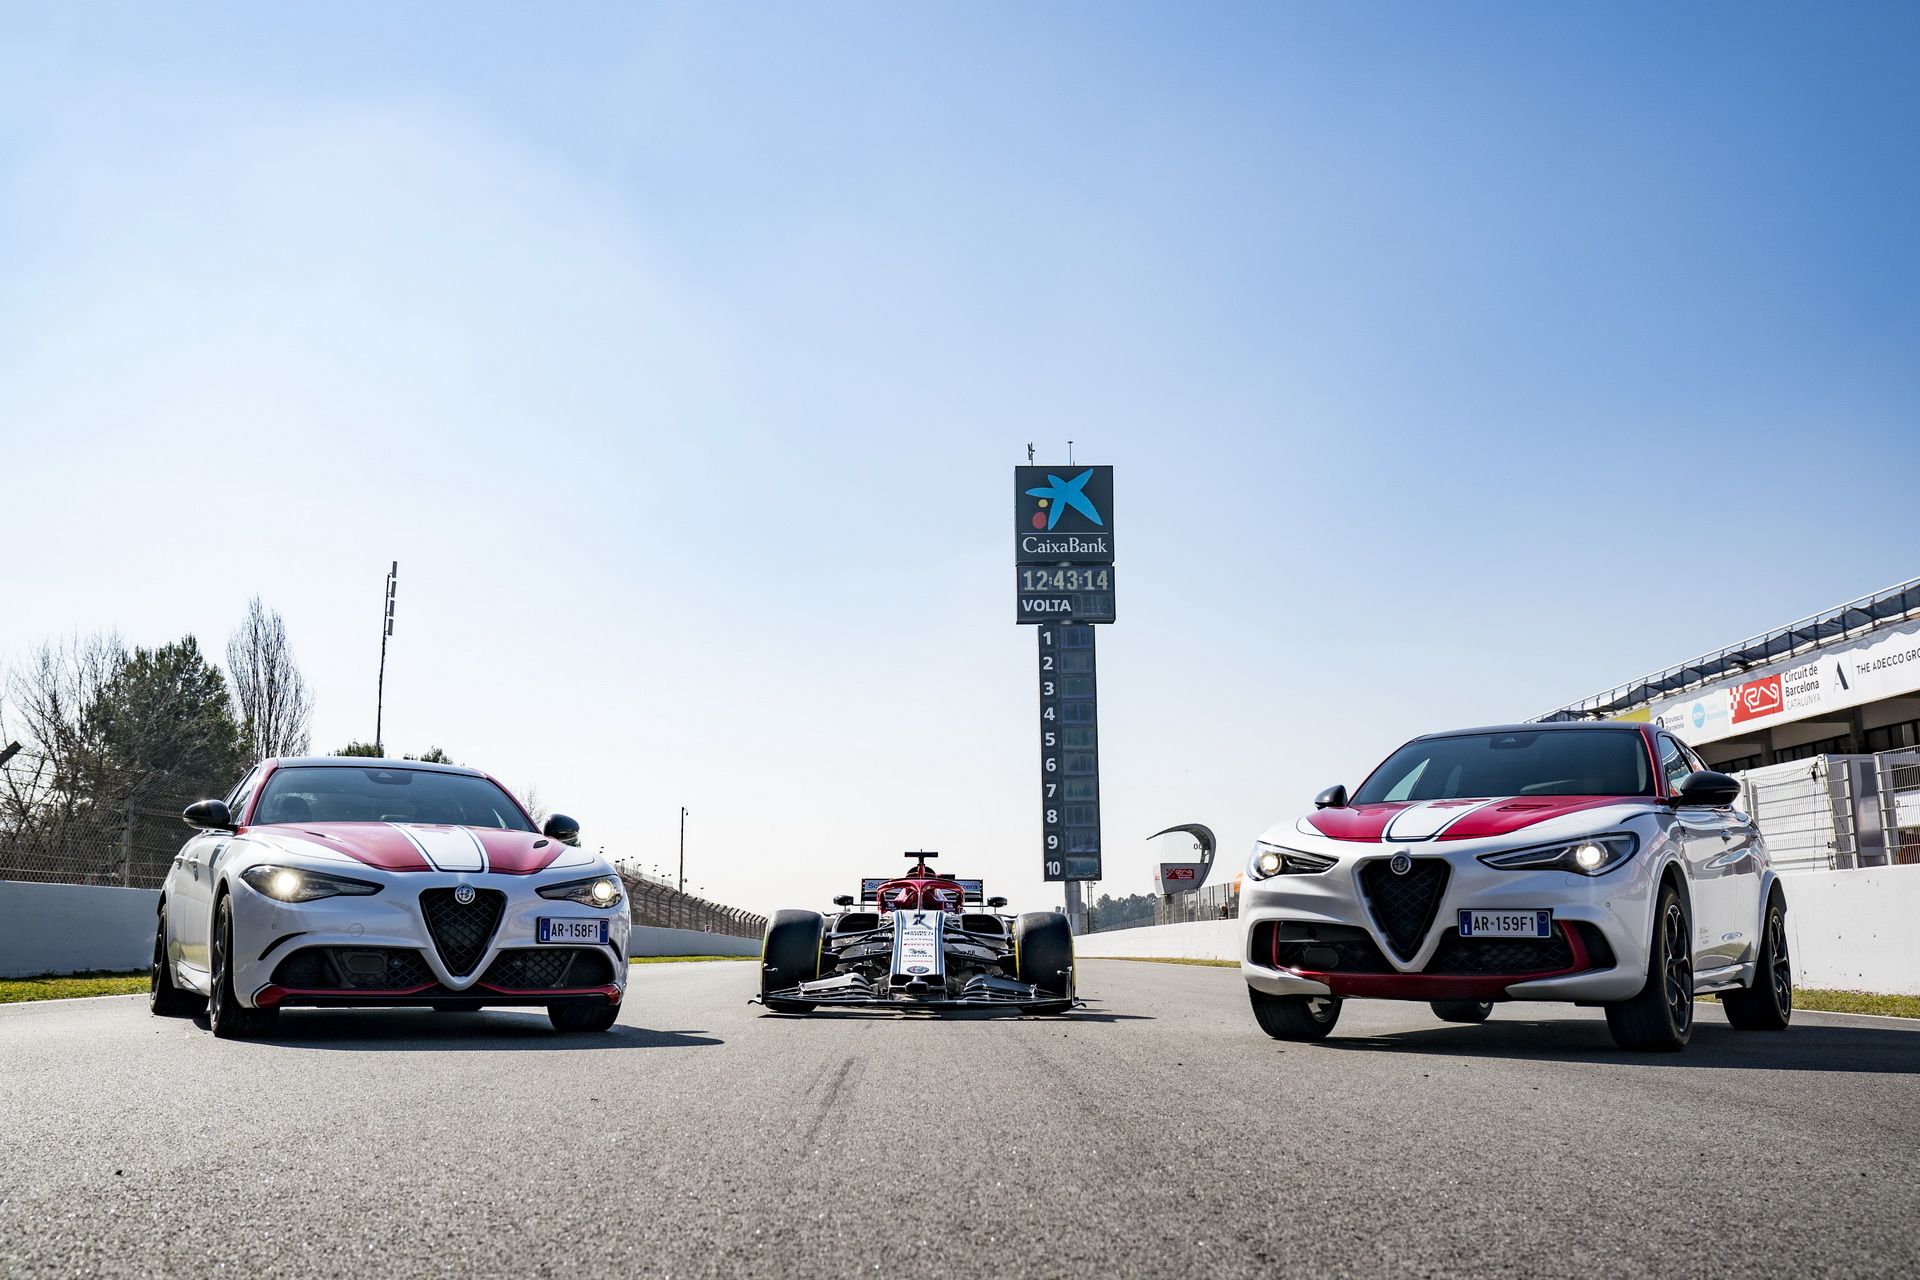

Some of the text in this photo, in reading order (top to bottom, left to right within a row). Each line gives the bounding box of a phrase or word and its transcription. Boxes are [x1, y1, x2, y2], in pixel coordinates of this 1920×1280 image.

[1022, 536, 1107, 553] CaixaBank
[1023, 570, 1108, 591] 12:43:14
[1022, 599, 1072, 612] VOLTA
[1043, 631, 1051, 645] 1
[1043, 656, 1054, 670] 2
[1856, 662, 1871, 675] THE
[1872, 653, 1904, 671] ADECCO
[1784, 664, 1818, 684] Circuit de
[1044, 681, 1055, 696] 3
[1785, 679, 1820, 697] Barcelona
[1786, 693, 1821, 710] CATALUNYA
[1043, 707, 1056, 721] 4
[1045, 732, 1055, 747] 5
[1046, 758, 1056, 772] 6
[1046, 783, 1057, 798] 7
[1047, 809, 1058, 824] 8
[1047, 835, 1058, 850] 9
[1046, 861, 1061, 876] 10
